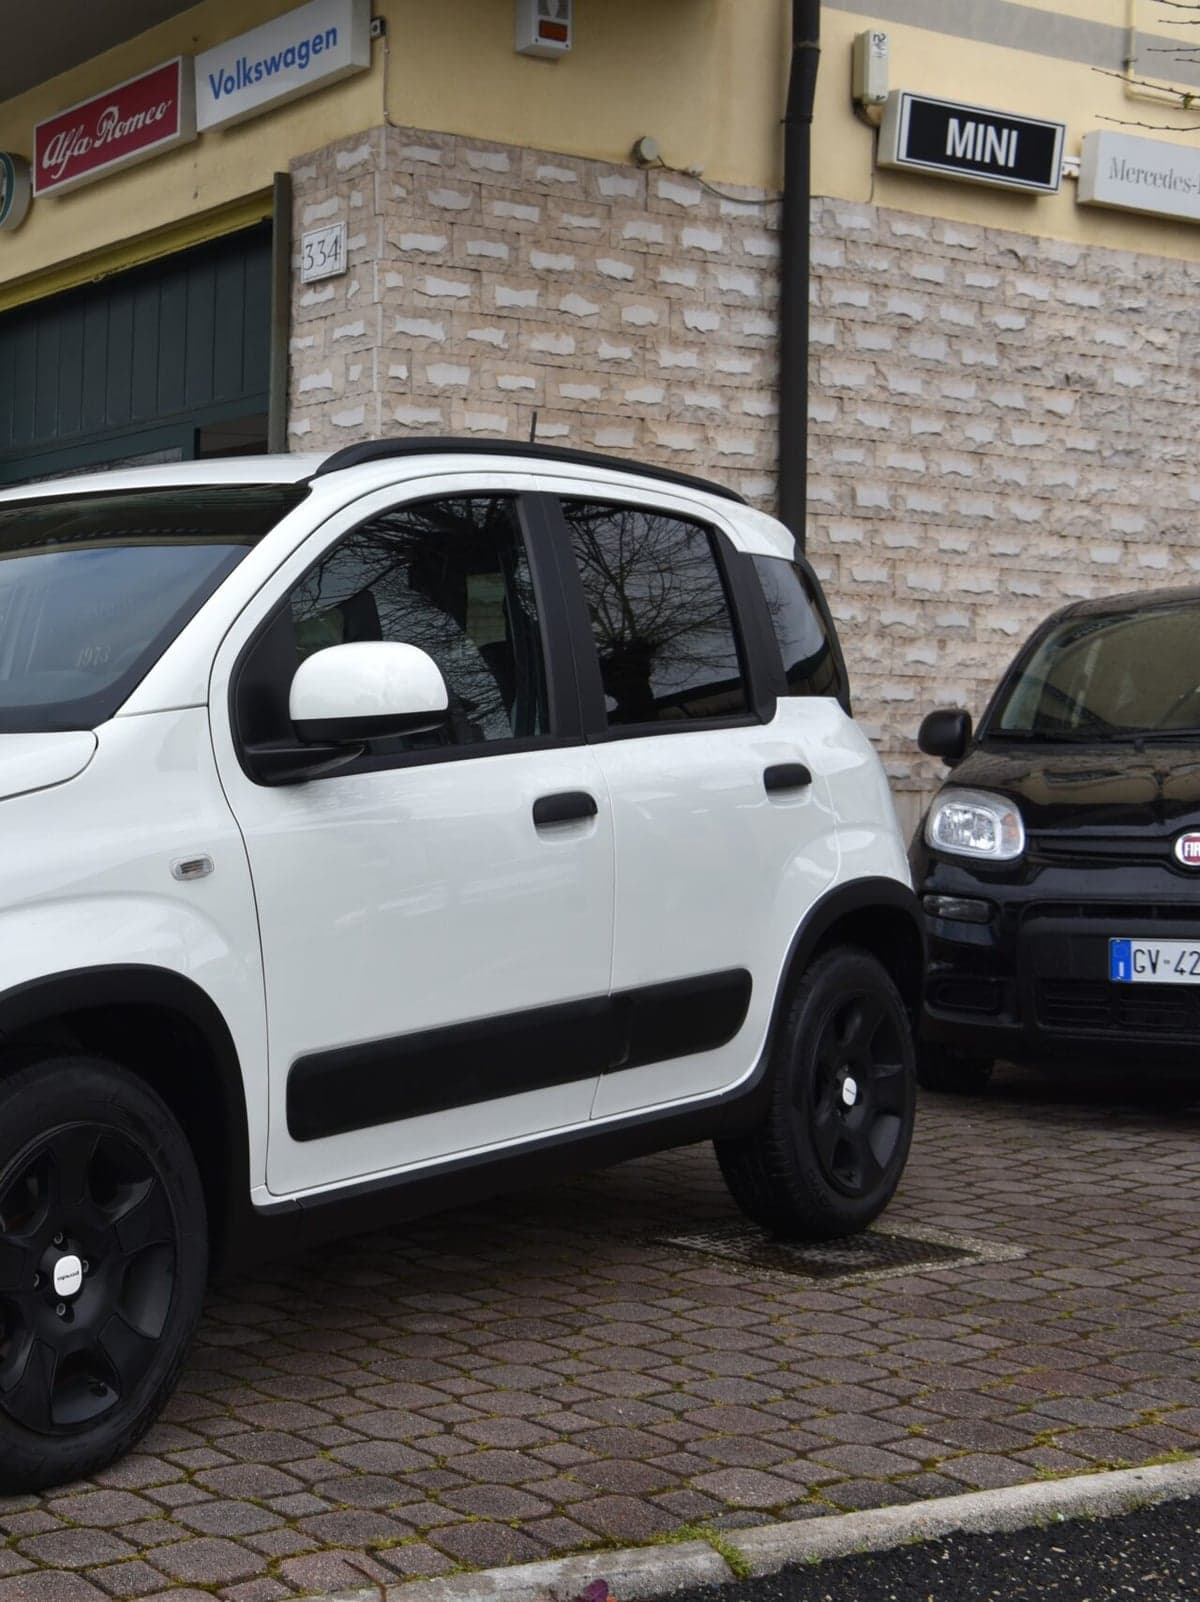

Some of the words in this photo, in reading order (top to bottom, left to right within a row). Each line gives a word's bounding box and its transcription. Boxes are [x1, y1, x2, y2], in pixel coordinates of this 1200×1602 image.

[208, 26, 338, 100] Volkswagen
[42, 124, 93, 179] Alfa
[93, 100, 172, 149] Romeo
[945, 117, 1019, 169] MINI
[1109, 157, 1200, 196] Mercedes-
[303, 235, 341, 271] 334
